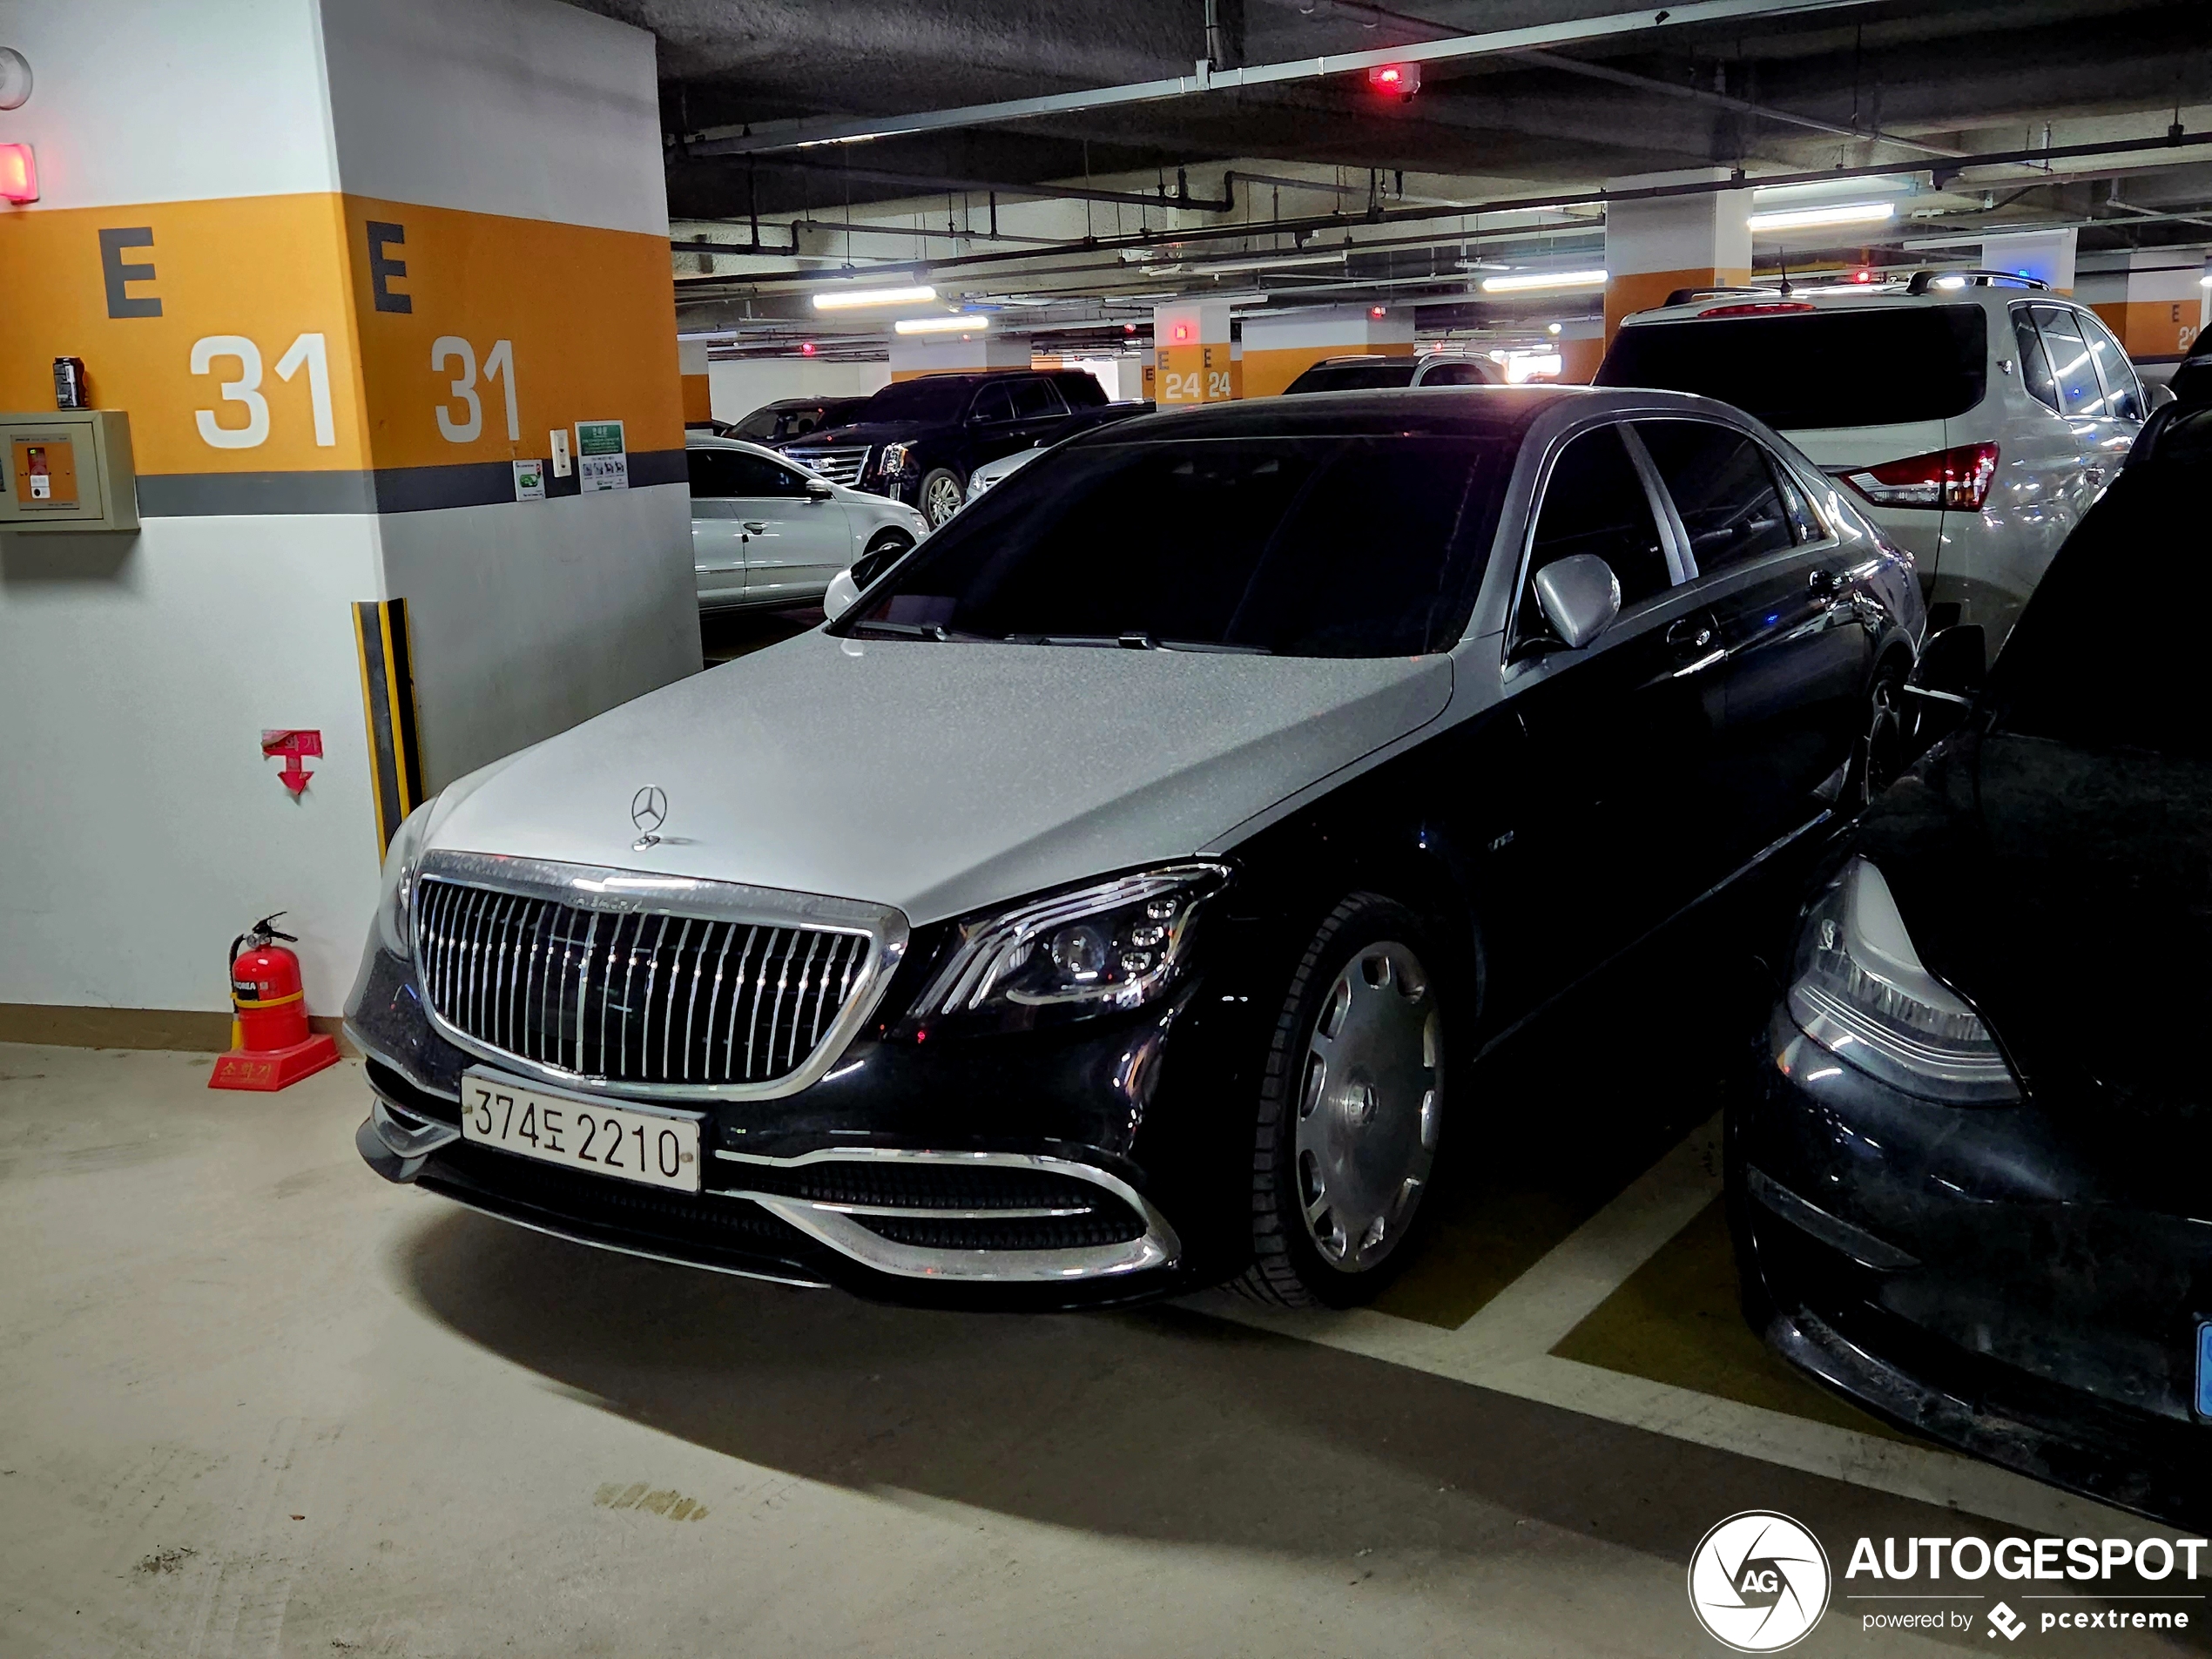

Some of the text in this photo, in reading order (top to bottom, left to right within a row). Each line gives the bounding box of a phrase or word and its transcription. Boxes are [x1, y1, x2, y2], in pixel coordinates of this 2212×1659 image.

[98, 226, 163, 319] E
[366, 220, 413, 314] E
[2172, 304, 2180, 322] E
[1157, 350, 1170, 371] E
[1204, 347, 1211, 368] E
[1145, 368, 1154, 381] E
[1165, 372, 1201, 399] 24
[1208, 371, 1231, 398] 24
[190, 332, 336, 449] 31
[431, 334, 522, 444] 31
[220, 1062, 272, 1079] 소화기
[475, 1089, 680, 1177] 374도 2210
